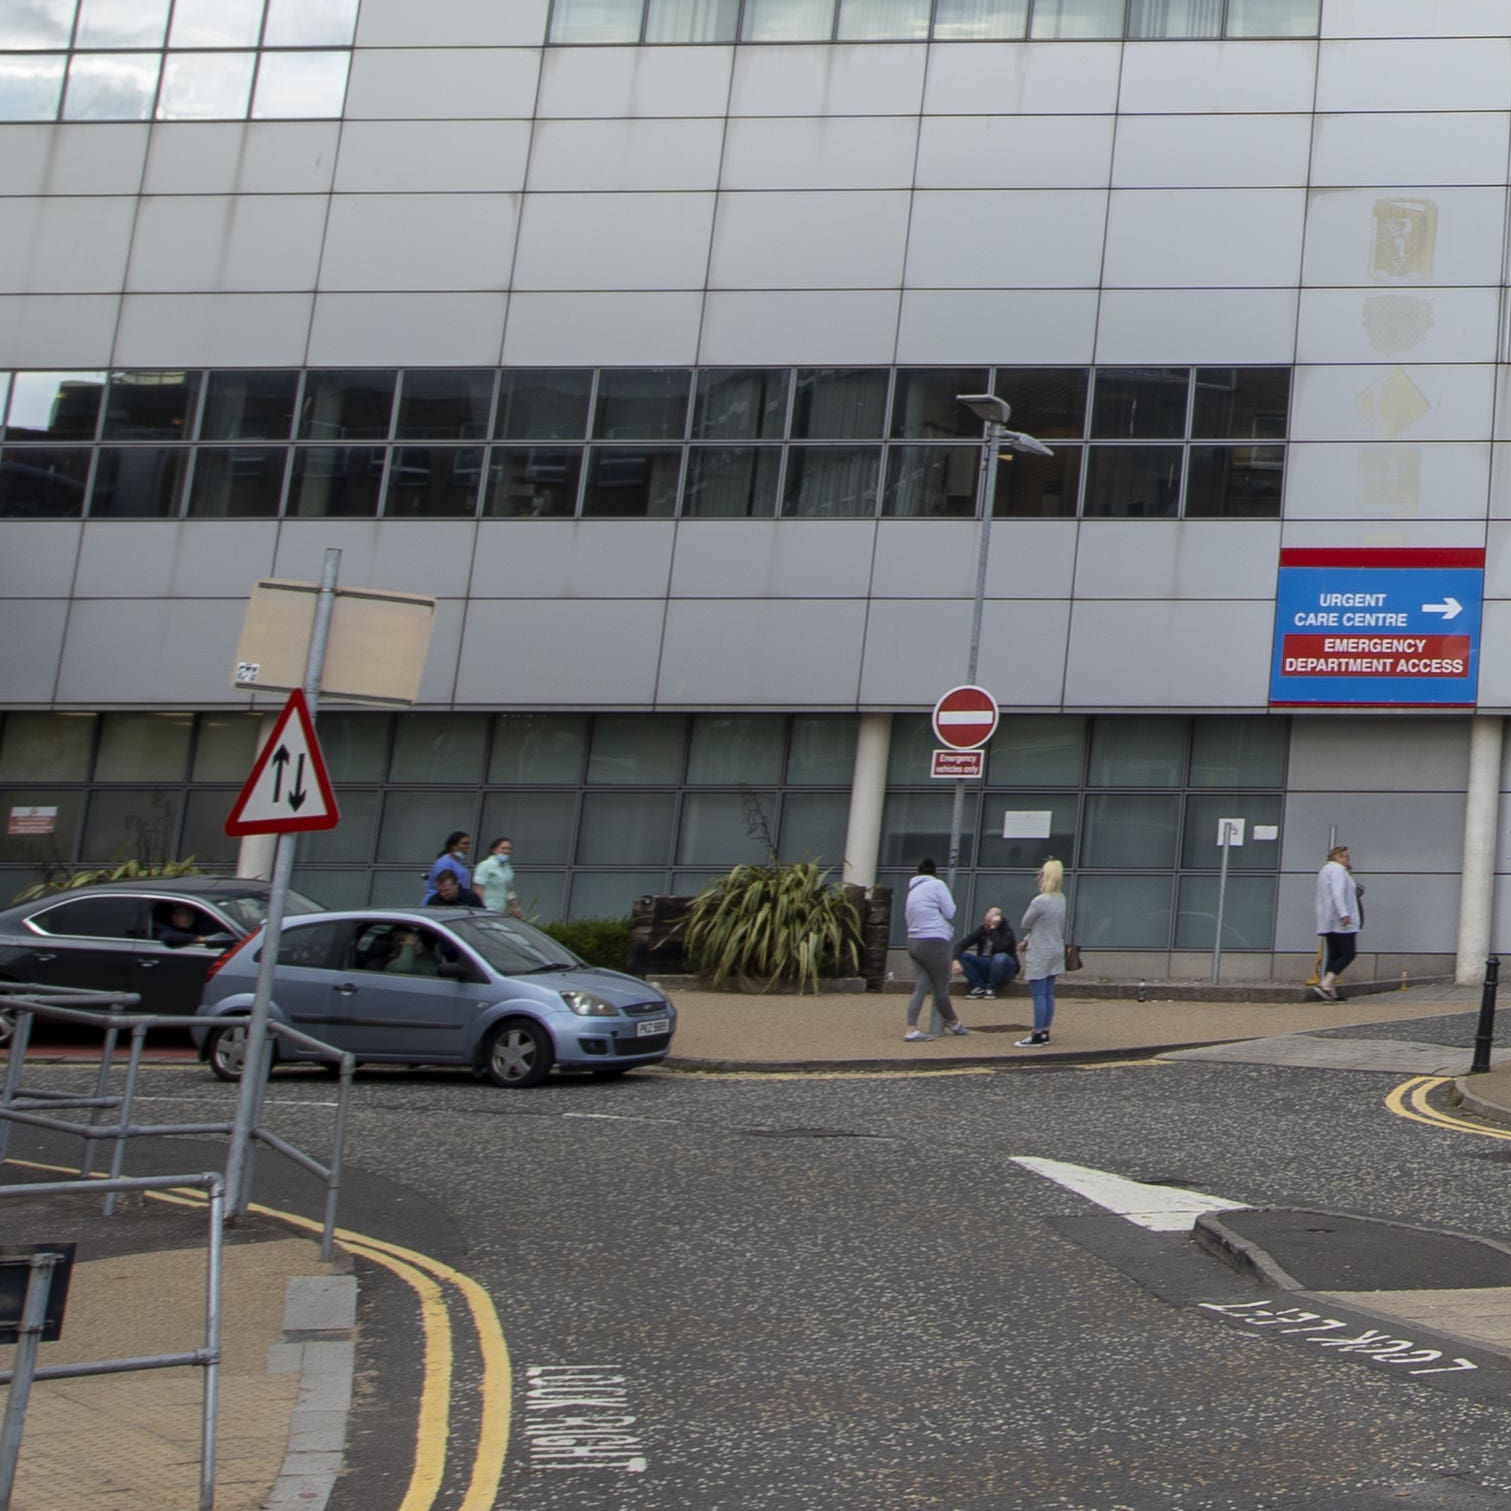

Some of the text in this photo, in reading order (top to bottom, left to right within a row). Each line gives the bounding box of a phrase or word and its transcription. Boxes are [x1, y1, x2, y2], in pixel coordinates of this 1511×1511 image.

[1319, 593, 1387, 607] URGENT
[1294, 613, 1408, 627] CARE CENTRE
[1324, 638, 1426, 653] EMERGENCY
[1285, 658, 1463, 674] DEPARTMENT ACCESS
[1198, 1299, 1478, 1375] LOOK LEFT
[524, 1364, 648, 1473] LOOK RIGHT
